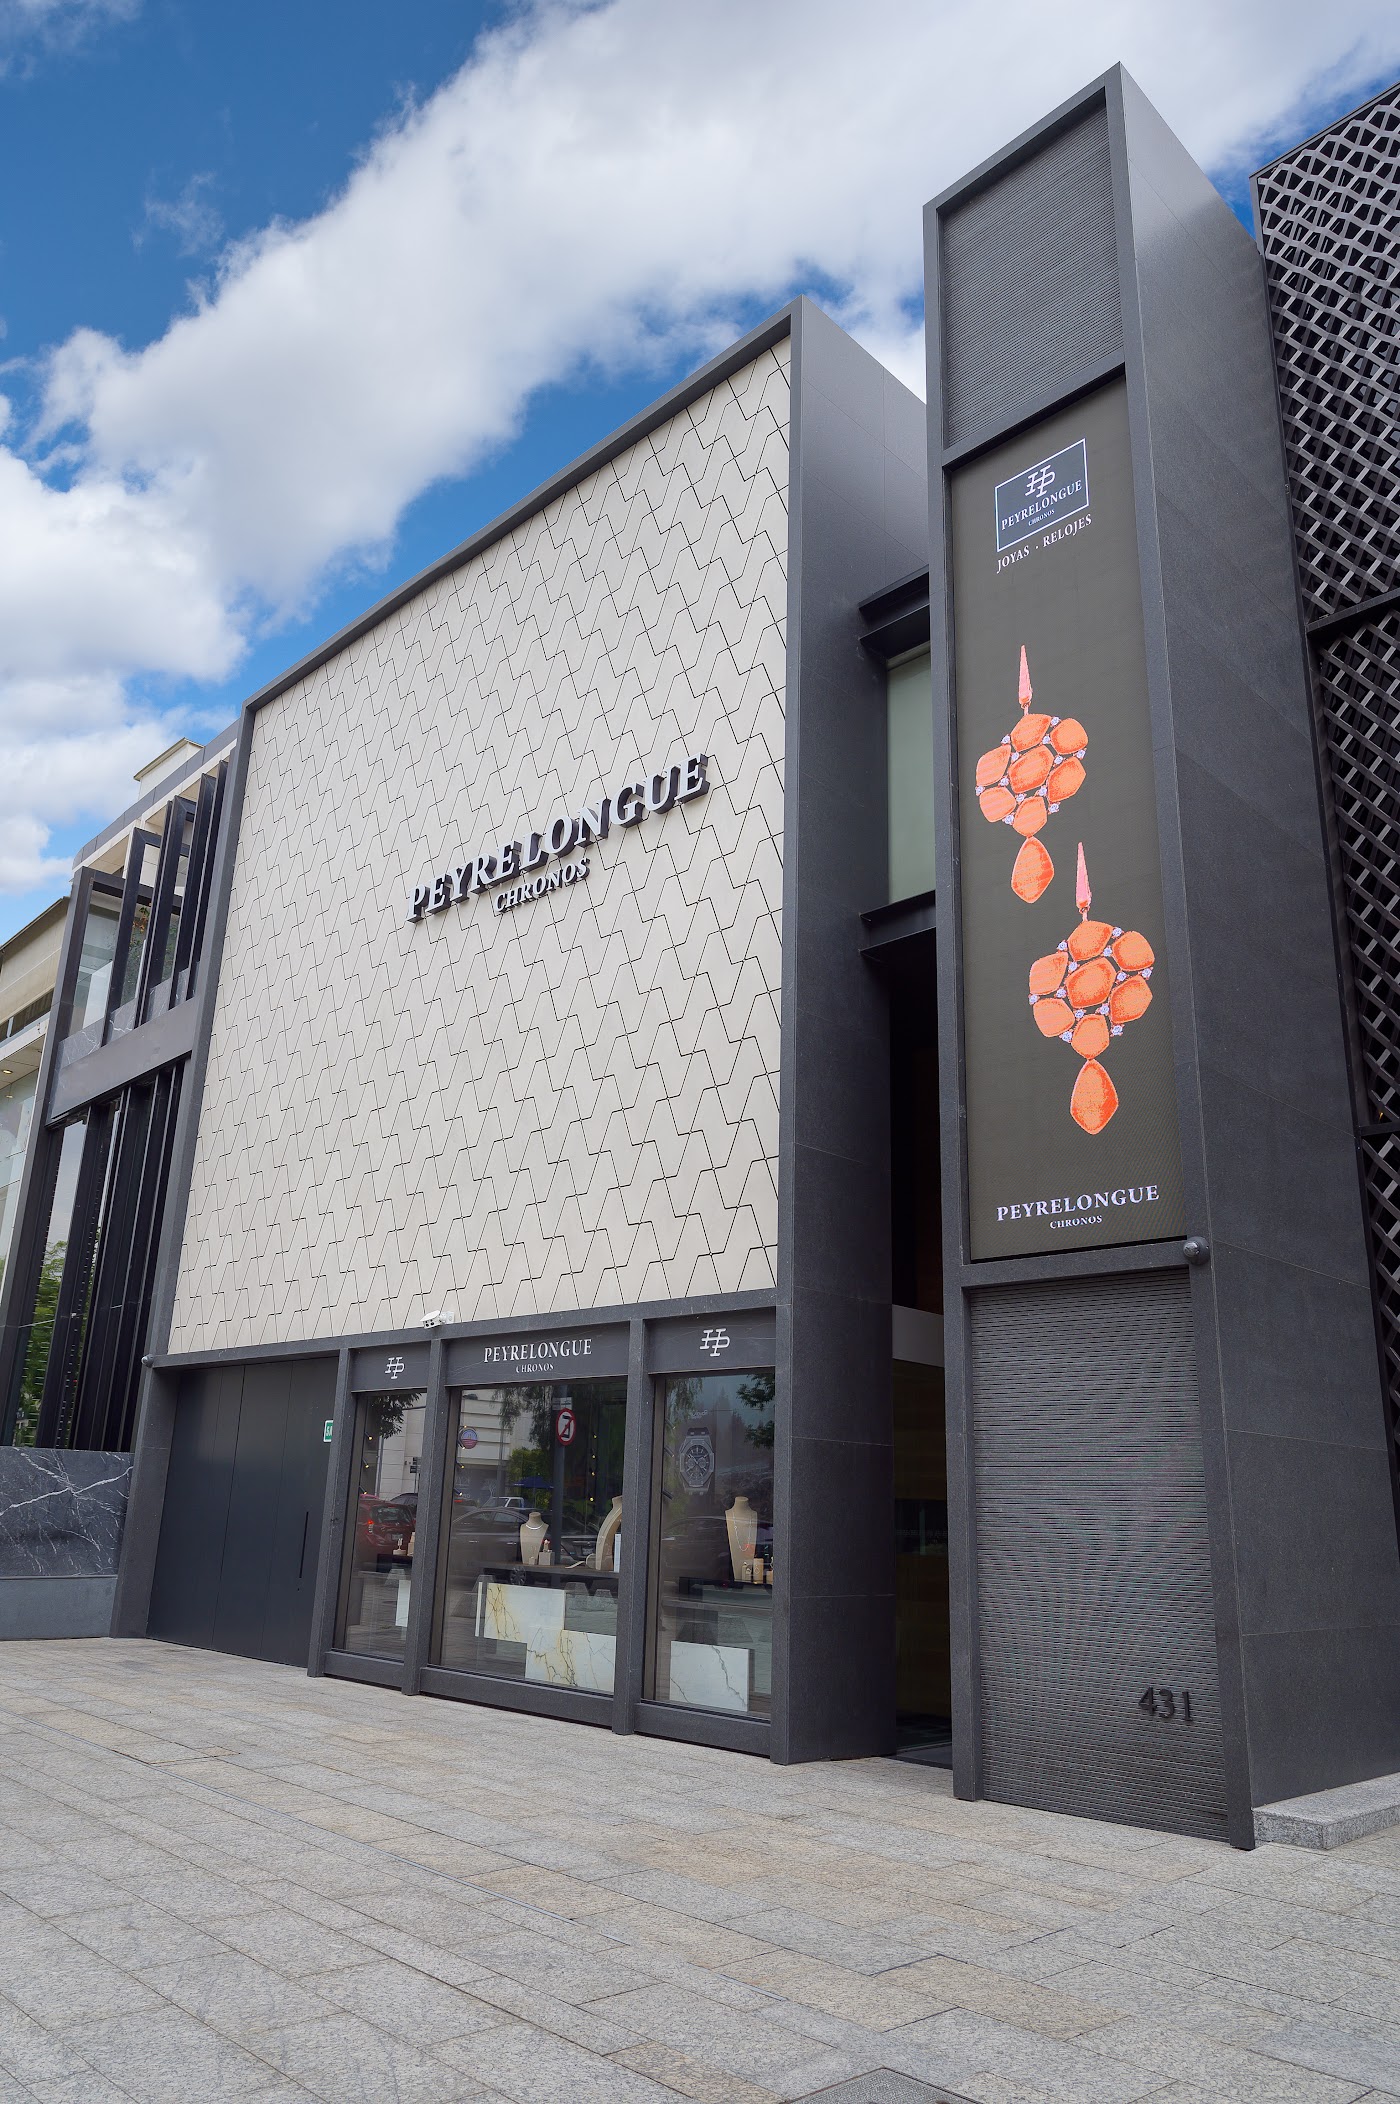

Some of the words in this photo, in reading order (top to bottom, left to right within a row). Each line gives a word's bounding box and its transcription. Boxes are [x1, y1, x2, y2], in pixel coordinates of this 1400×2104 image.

[1001, 479, 1082, 531] PEYRELONGUE
[1028, 509, 1055, 526] CHRONOS
[996, 545, 1030, 574] JOYAS
[1042, 514, 1092, 547] RELOJES
[406, 752, 710, 923] PEYRELONGUE
[494, 857, 590, 913] CHRONOS
[996, 1185, 1160, 1222] PEYRELONGUE
[1050, 1215, 1103, 1229] CHRONOS
[484, 1339, 592, 1362] PEYRELONGUE
[516, 1363, 554, 1373] CHRONOS
[1138, 1686, 1193, 1722] 431
